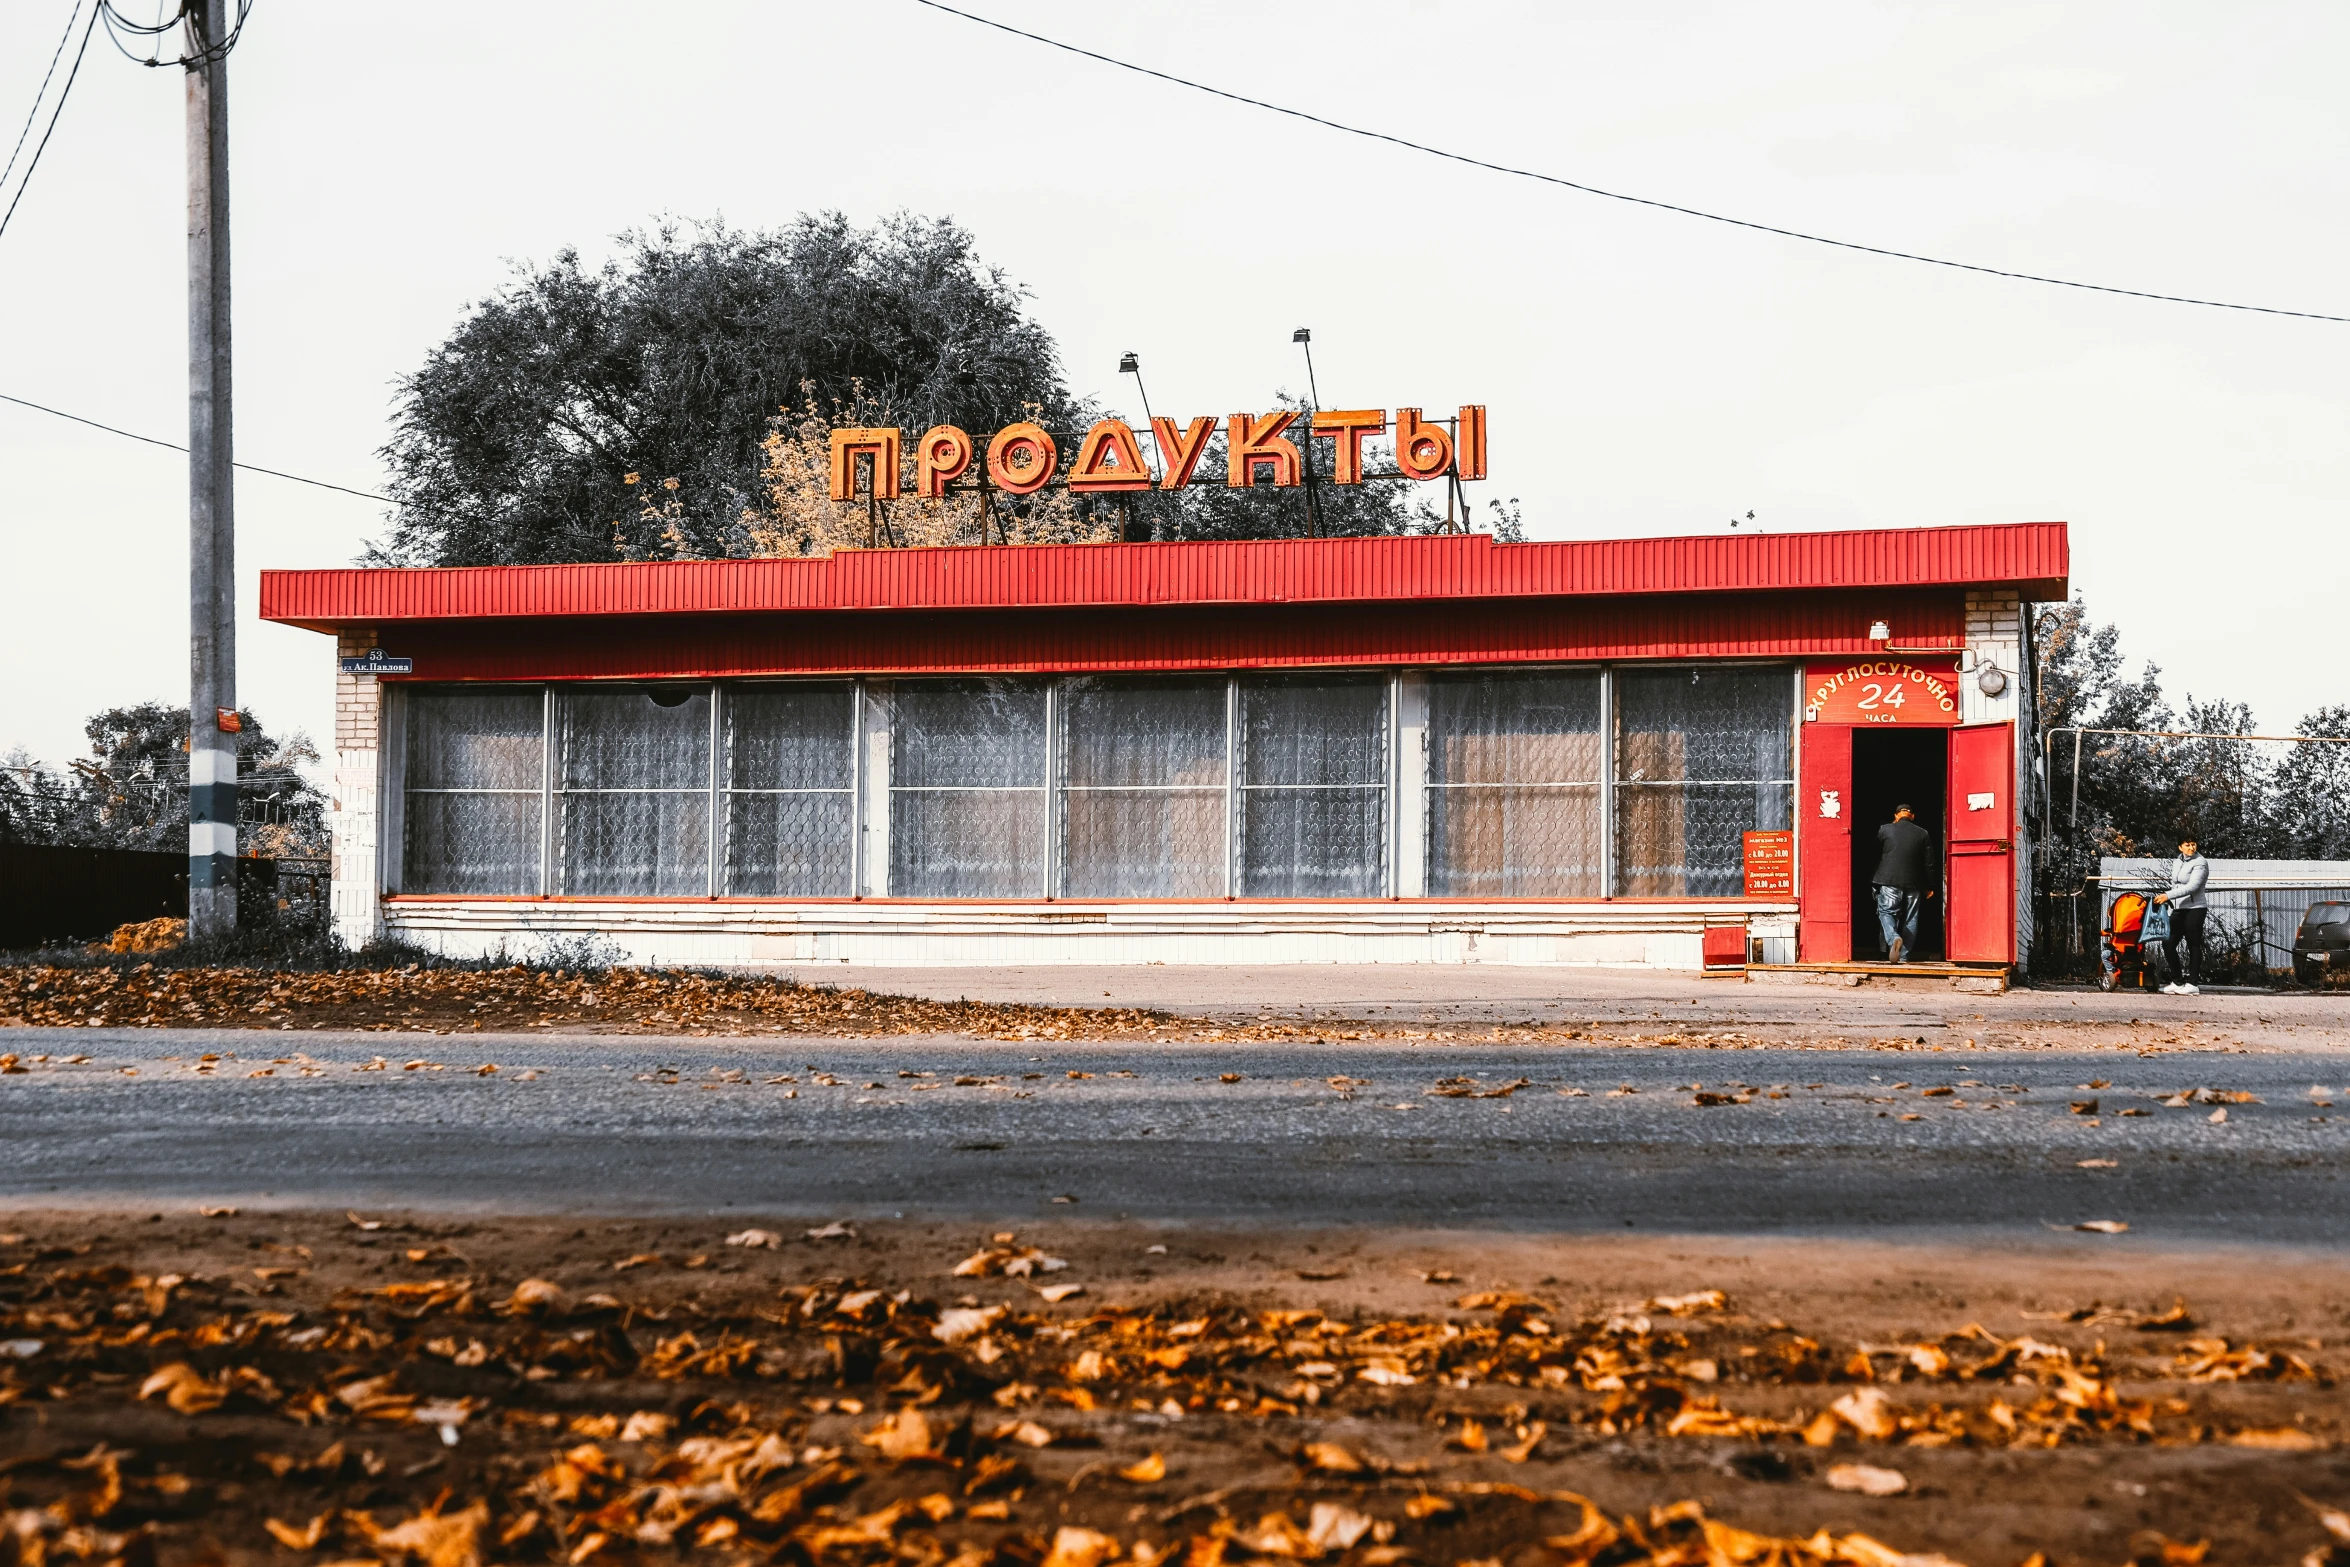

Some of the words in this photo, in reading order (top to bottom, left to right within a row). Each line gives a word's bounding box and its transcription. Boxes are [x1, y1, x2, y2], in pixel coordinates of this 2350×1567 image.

[831, 404, 1487, 501] ПРОДУКТЫ
[369, 651, 383, 661] 53
[1809, 662, 1954, 712] КРУГЛОСУТОЧНО
[1857, 683, 1906, 710] 24
[1865, 714, 1897, 723] ЧАСА
